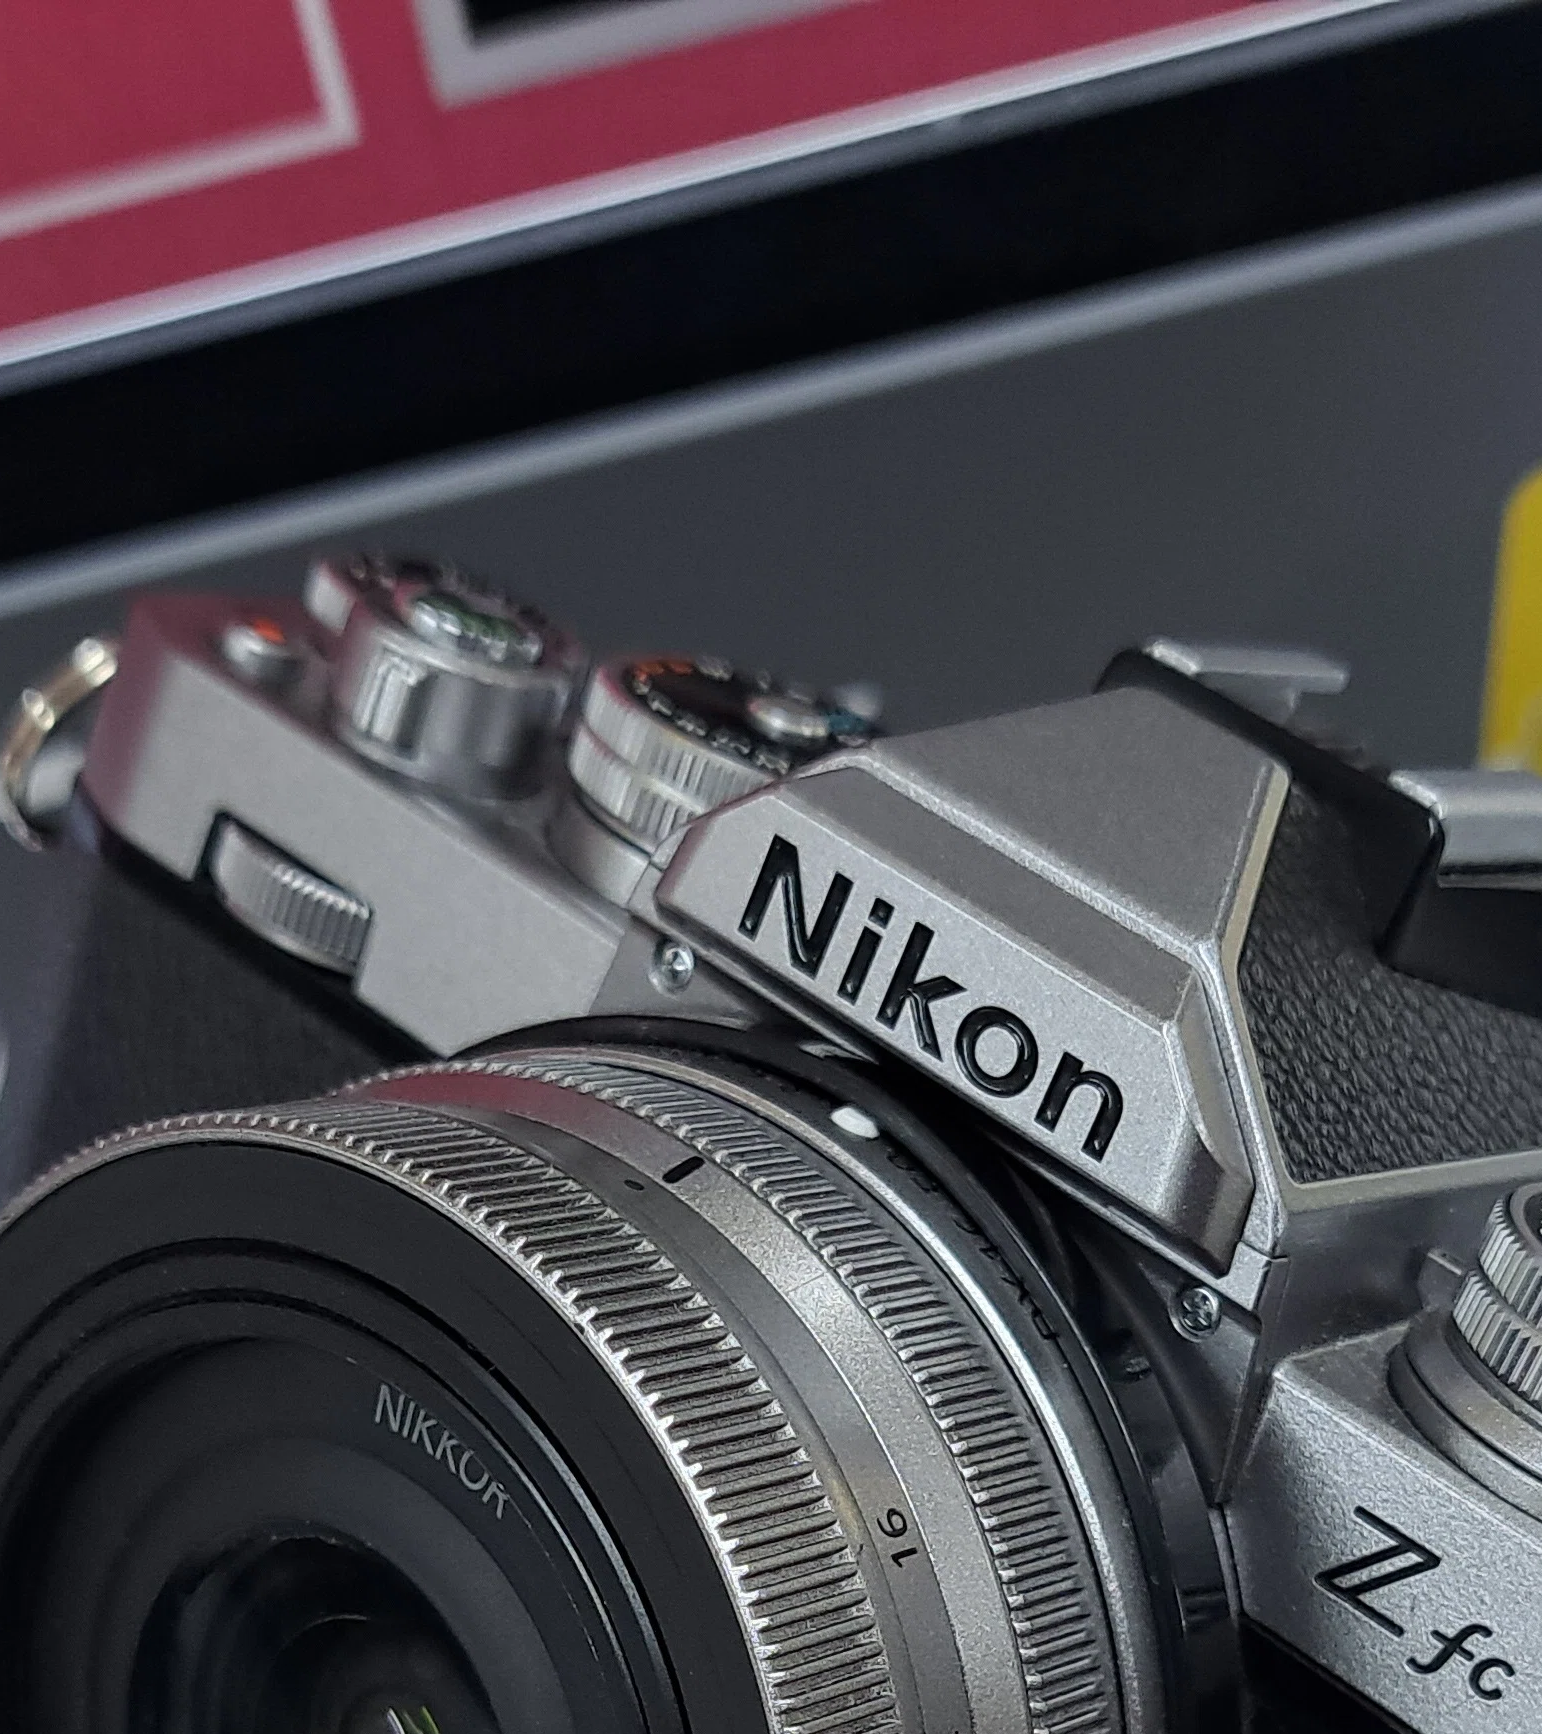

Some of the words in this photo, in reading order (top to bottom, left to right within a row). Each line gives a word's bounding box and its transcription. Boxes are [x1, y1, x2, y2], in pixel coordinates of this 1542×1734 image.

[737, 833, 1124, 1164] Nikon
[375, 1384, 509, 1520] NIKKOR
[877, 1508, 918, 1568] 16
[1314, 1505, 1442, 1638] Z
[1406, 1623, 1516, 1701] fc
